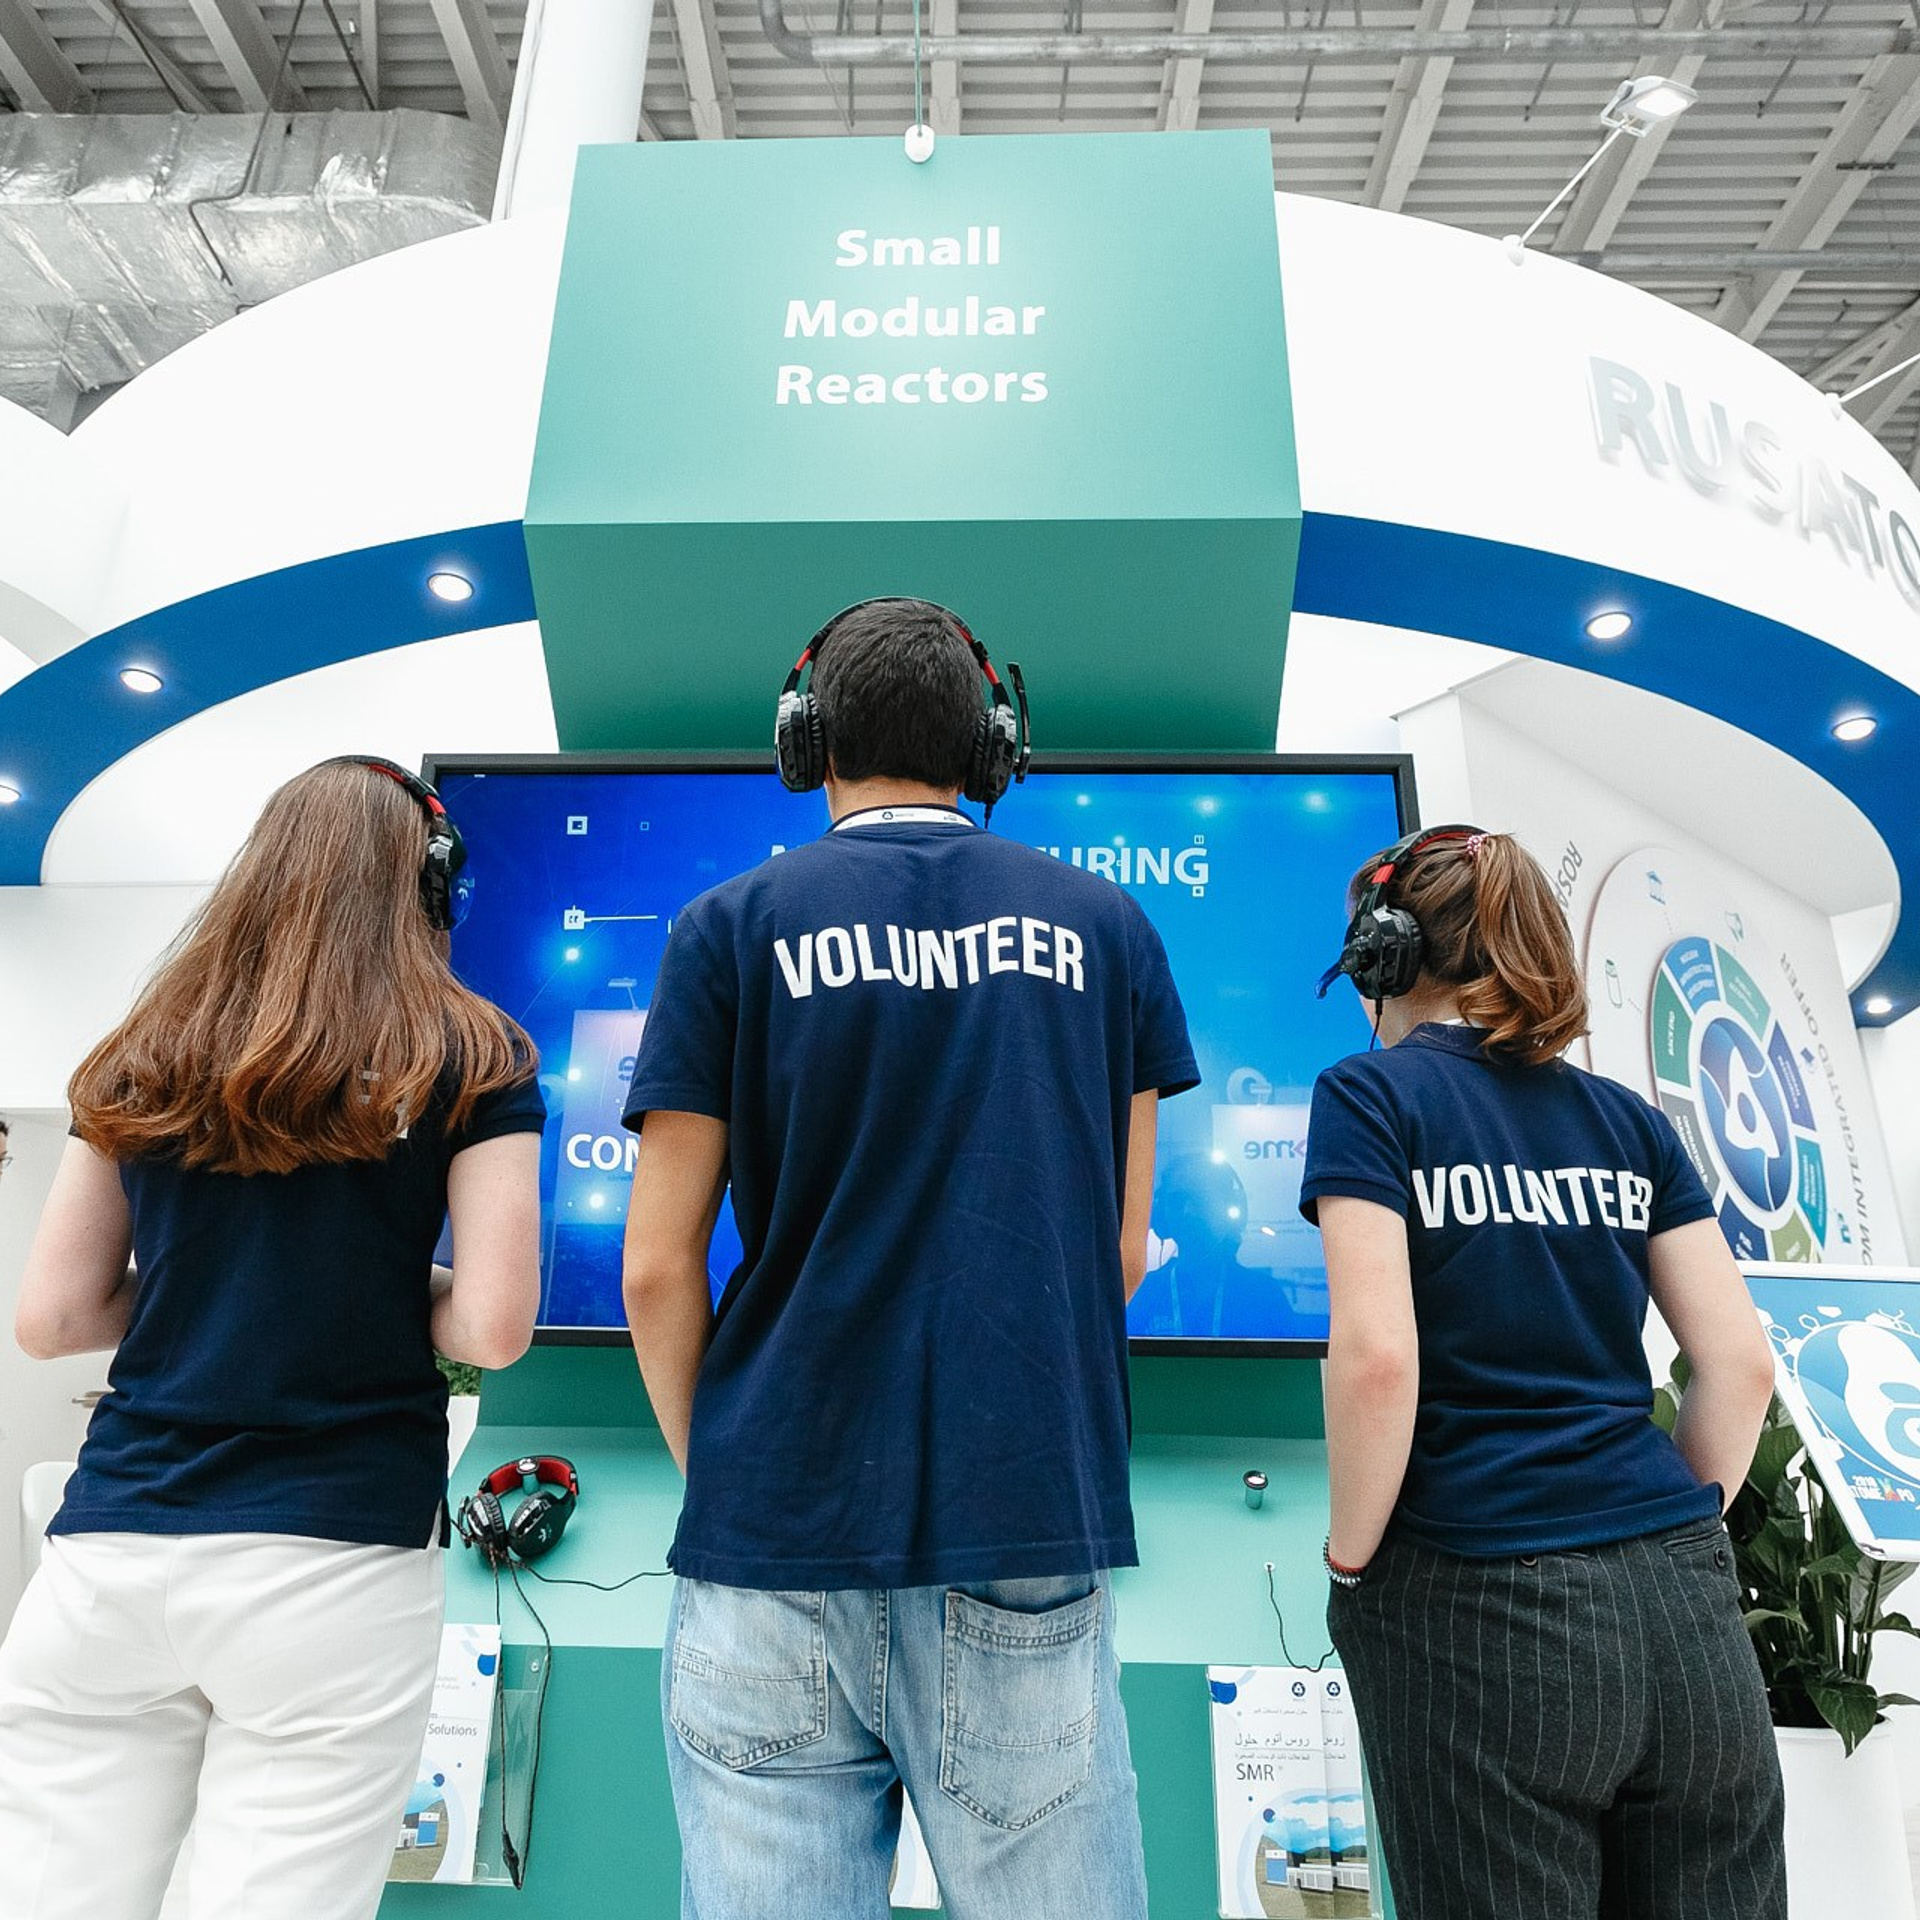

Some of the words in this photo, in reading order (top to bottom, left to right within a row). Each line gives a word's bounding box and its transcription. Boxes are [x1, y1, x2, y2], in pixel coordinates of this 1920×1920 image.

[835, 226, 1000, 267] Small
[784, 296, 1046, 338] Modular
[775, 364, 1050, 405] Reactors
[773, 916, 1085, 999] VOLUNTEER
[428, 1723, 477, 1736] Solutions
[1236, 1762, 1275, 1782] SMR
